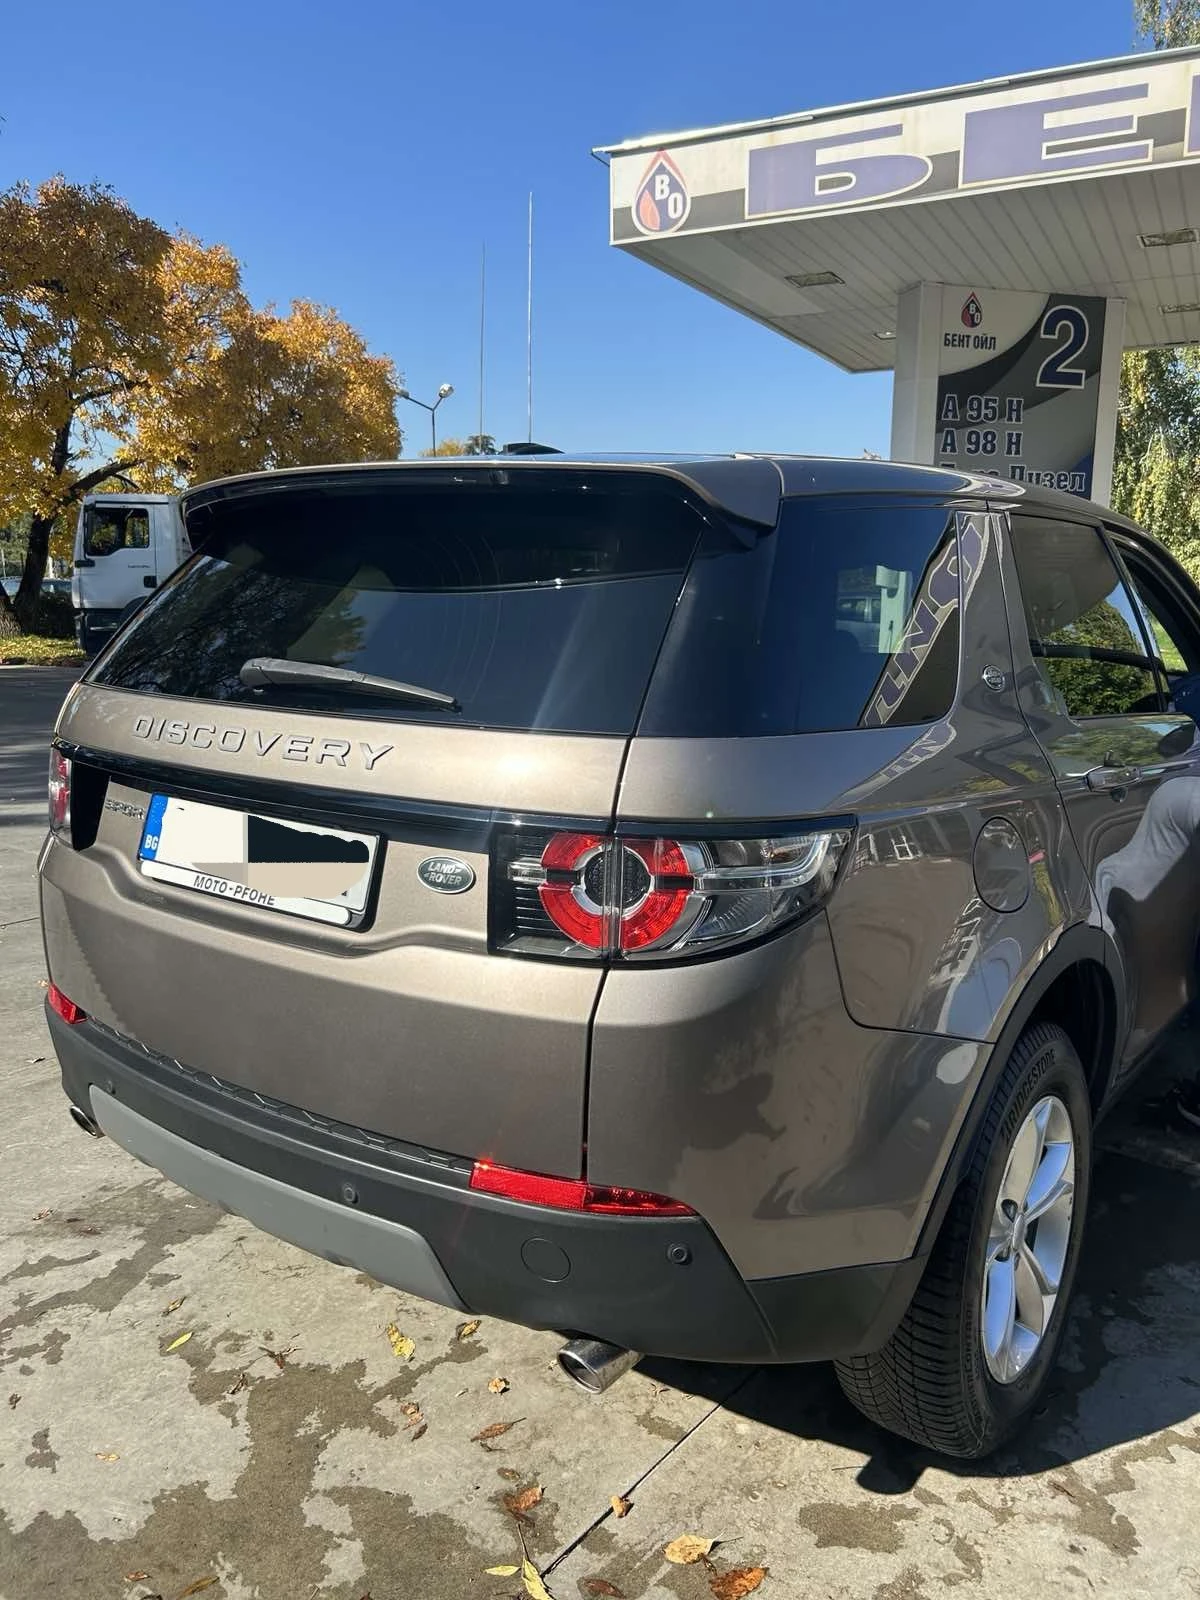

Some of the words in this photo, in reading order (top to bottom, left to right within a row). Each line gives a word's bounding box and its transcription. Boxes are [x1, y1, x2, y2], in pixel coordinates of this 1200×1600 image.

[743, 72, 1200, 219] БЕ
[944, 333, 971, 348] БЕНТ
[974, 333, 996, 350] ОЙЛ
[1036, 305, 1089, 389] 2
[941, 394, 960, 420] А
[967, 395, 999, 423] 95
[1005, 397, 1024, 424] Н
[940, 428, 958, 454] А
[965, 429, 997, 455] 98
[1005, 431, 1023, 456] Н
[132, 715, 394, 770] DISCOVERY
[144, 834, 159, 850] BG
[428, 862, 457, 874] LAND
[429, 872, 462, 885] ROVER
